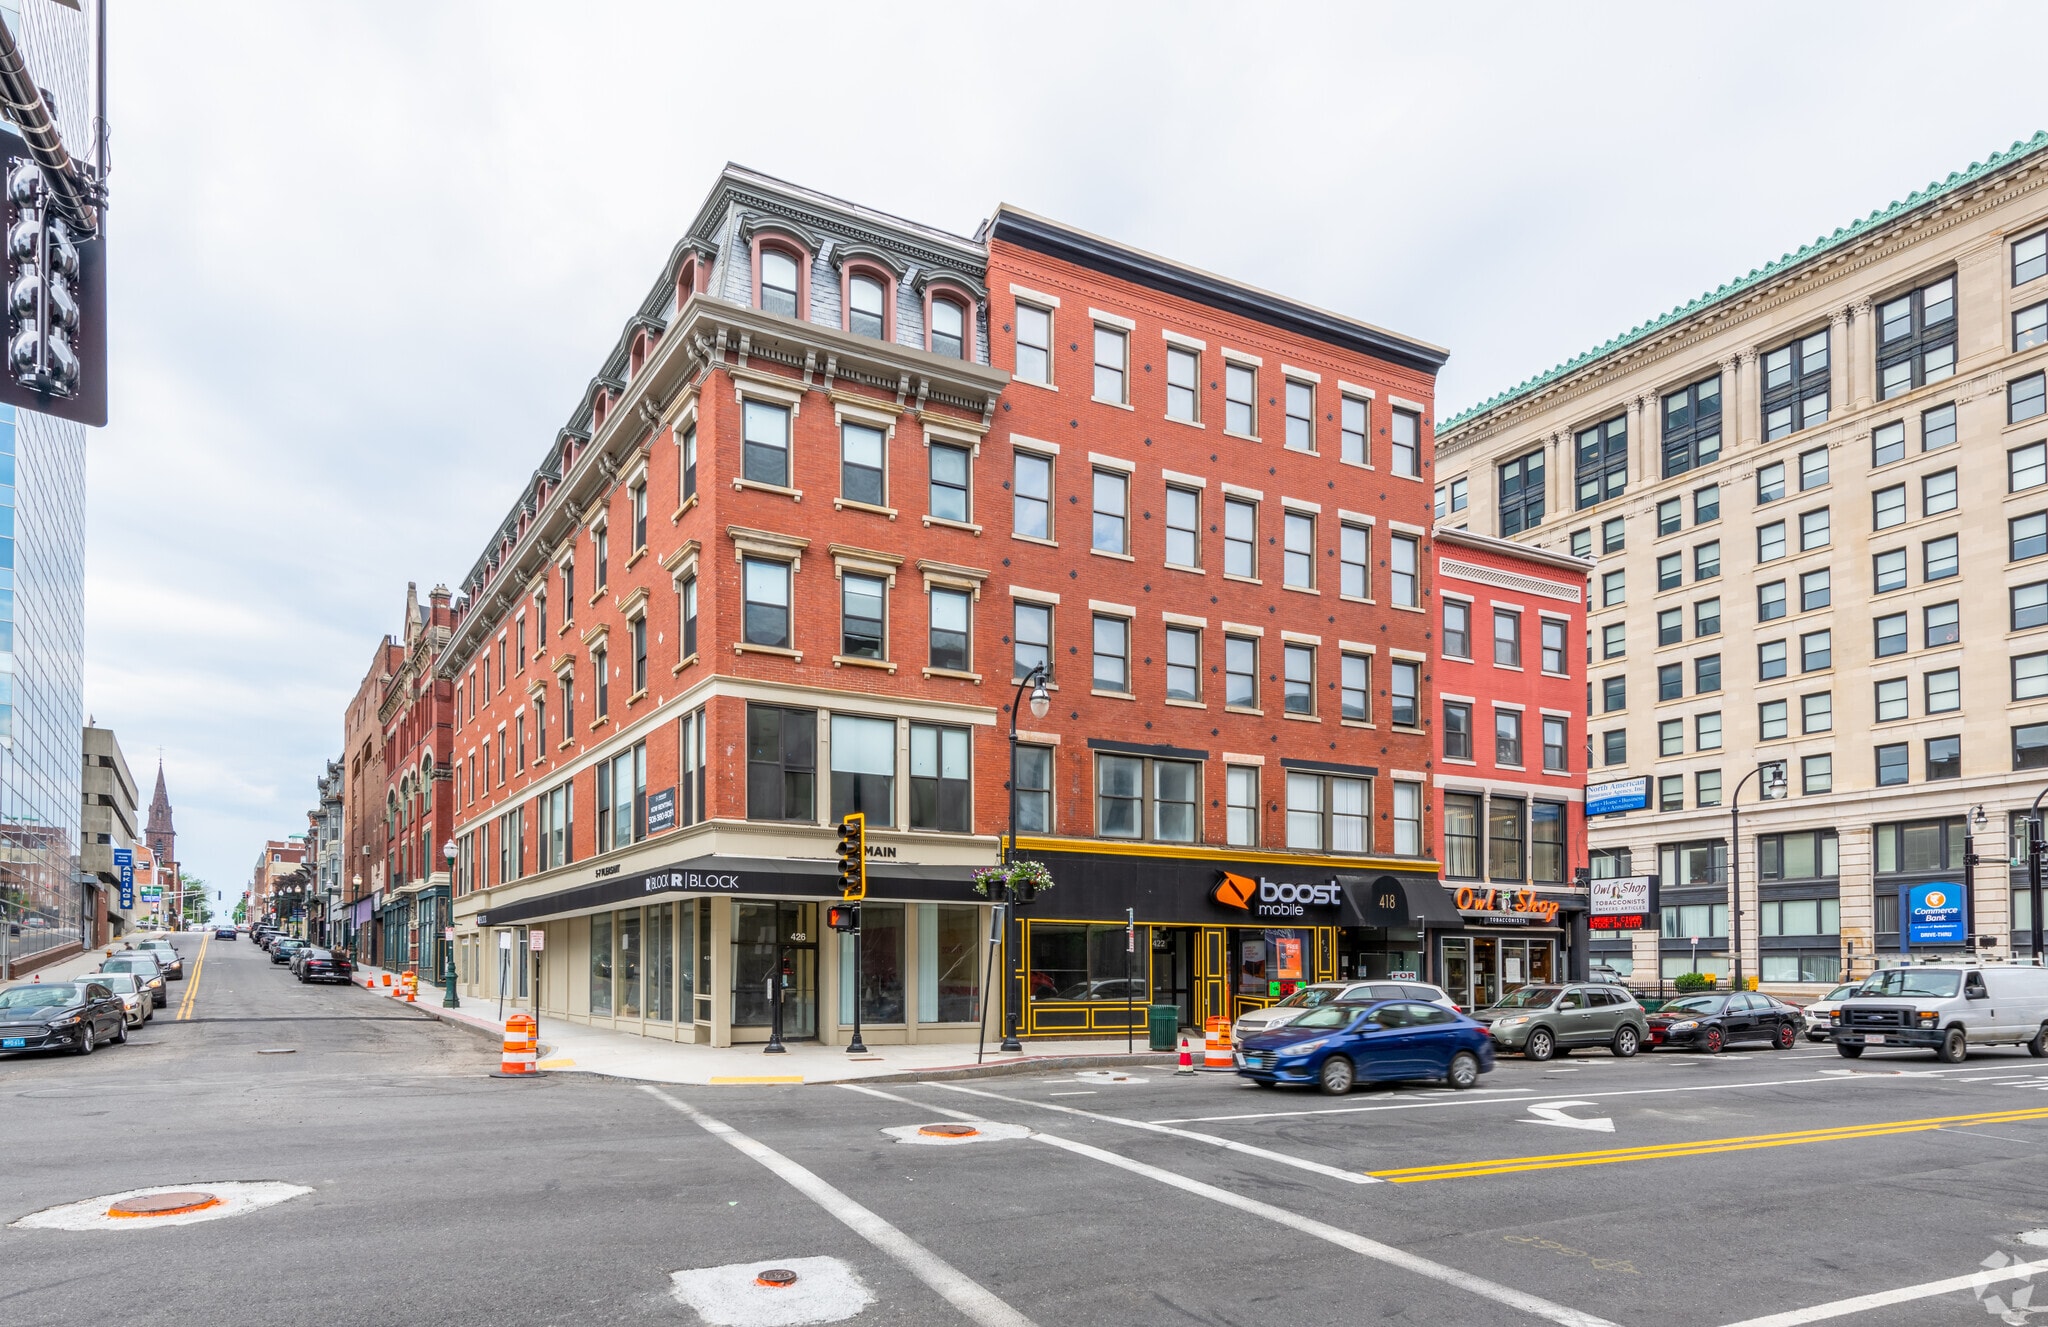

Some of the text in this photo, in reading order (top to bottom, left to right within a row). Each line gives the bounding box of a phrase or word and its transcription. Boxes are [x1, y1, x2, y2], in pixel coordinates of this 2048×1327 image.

[1588, 779, 1645, 792] North American
[864, 846, 896, 858] MAIN
[690, 874, 739, 888] BLOCK
[1260, 876, 1342, 905] boost
[1594, 882, 1646, 896] Owl Shop
[1379, 894, 1396, 908] 418
[1456, 886, 1560, 922] Owl Shop
[1258, 903, 1304, 916] mobile
[790, 933, 806, 941] 426
